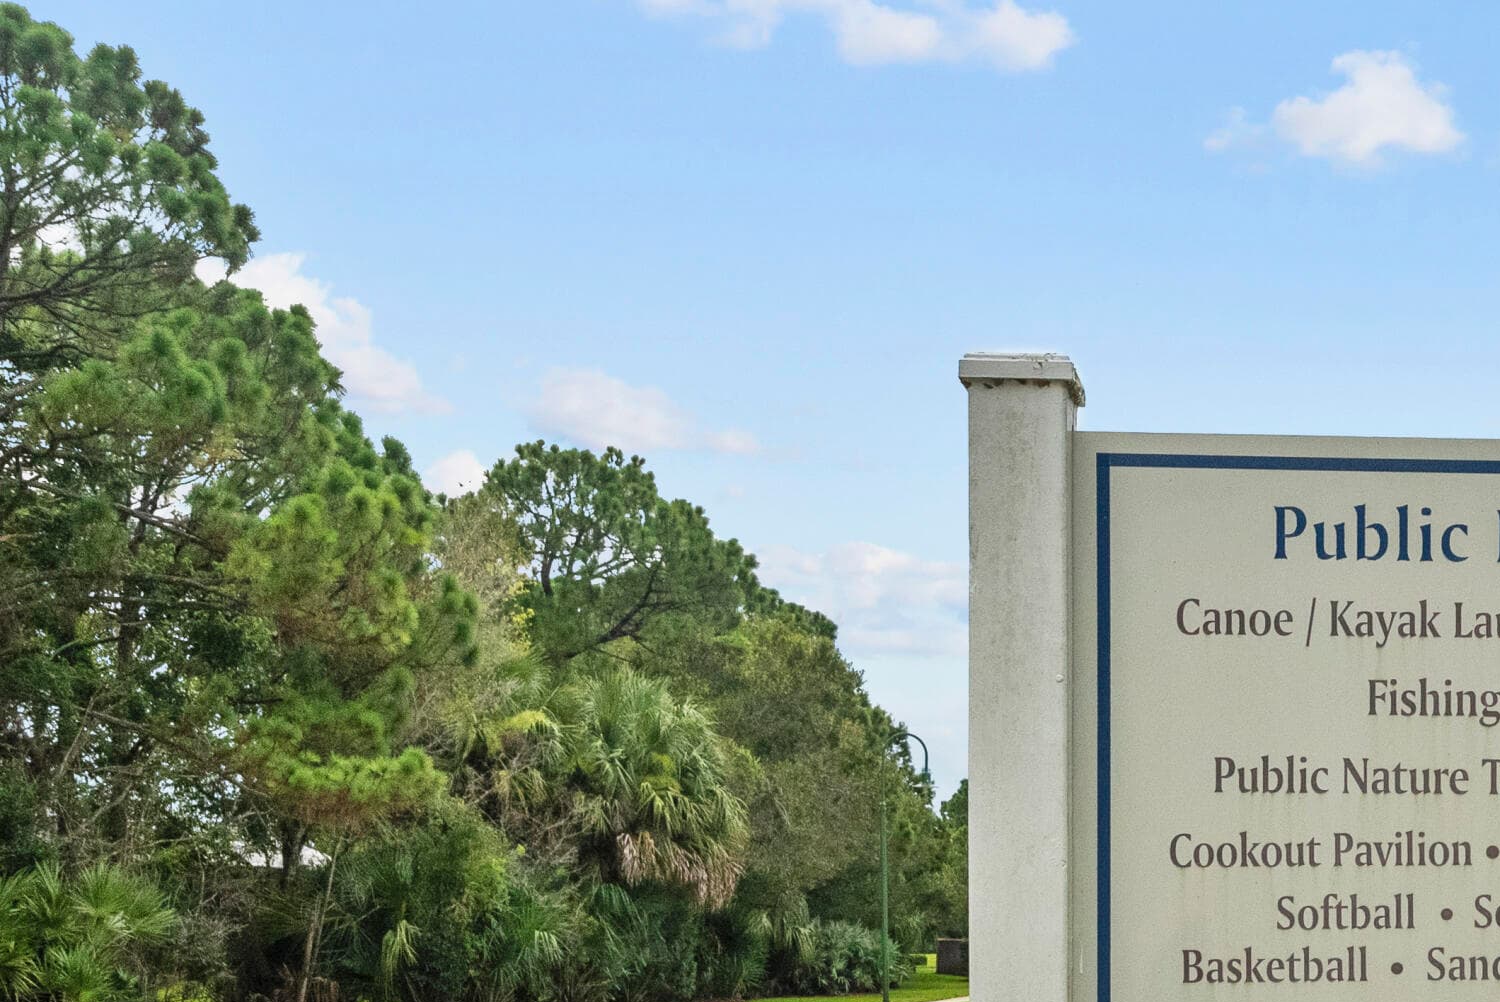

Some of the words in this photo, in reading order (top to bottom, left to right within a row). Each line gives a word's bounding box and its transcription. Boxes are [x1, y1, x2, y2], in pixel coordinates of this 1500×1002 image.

[1273, 503, 1469, 563] Public
[1176, 597, 1294, 637] Canoe
[1305, 596, 1317, 648] /
[1329, 599, 1442, 649] Kayak
[1214, 754, 1329, 795] Public
[1342, 757, 1470, 796] Nature
[1169, 830, 1322, 870] Cookout
[1333, 829, 1473, 868] Pavilion
[1276, 892, 1416, 932] Softball
[1181, 945, 1369, 985] Basketball
